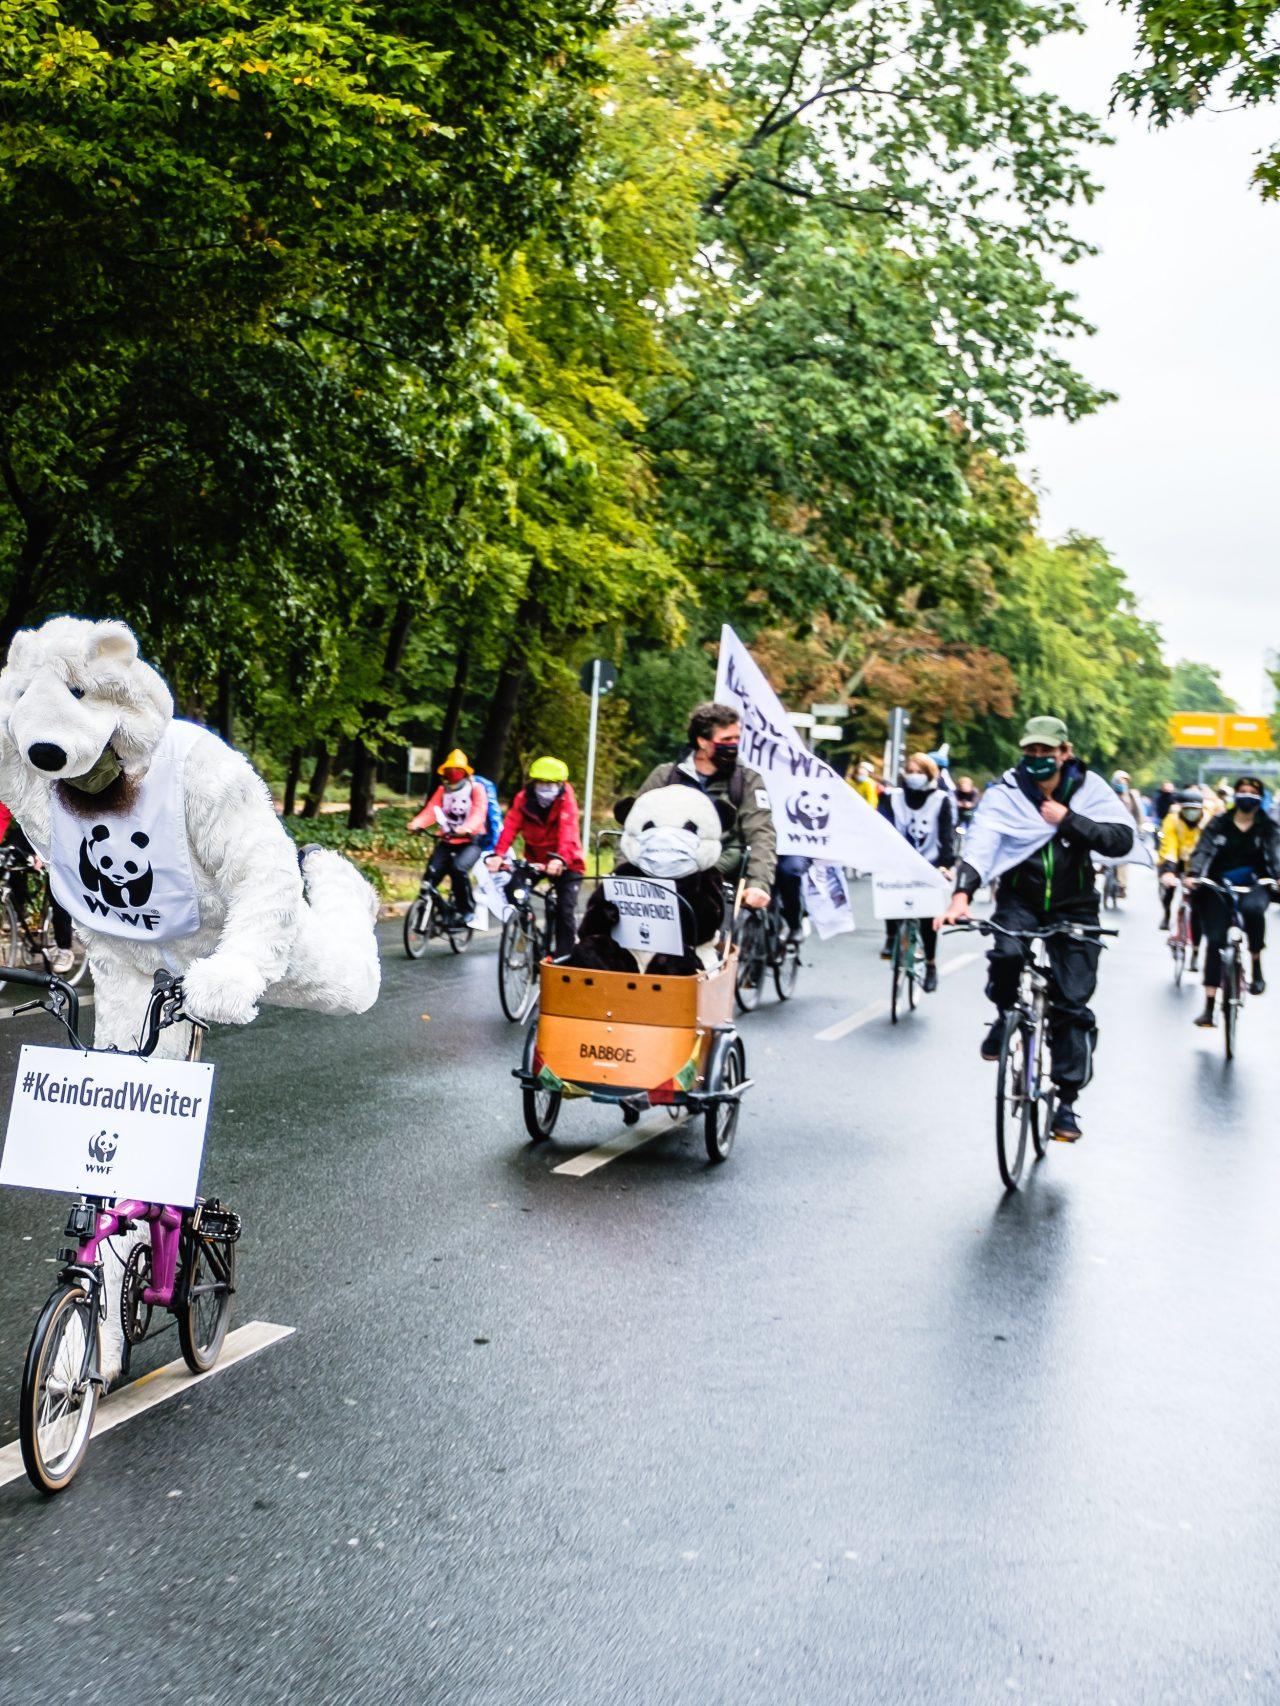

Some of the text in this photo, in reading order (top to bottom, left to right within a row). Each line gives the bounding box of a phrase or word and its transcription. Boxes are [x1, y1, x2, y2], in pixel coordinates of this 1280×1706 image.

[788, 833, 829, 845] WWF
[614, 881, 666, 900] STILL LOVING
[83, 894, 161, 931] WWF
[613, 901, 675, 920] ERGIEWENDE!
[580, 1043, 637, 1063] BABBOE
[22, 1071, 202, 1118] #KeinGradWeiter
[85, 1163, 114, 1175] WWF
